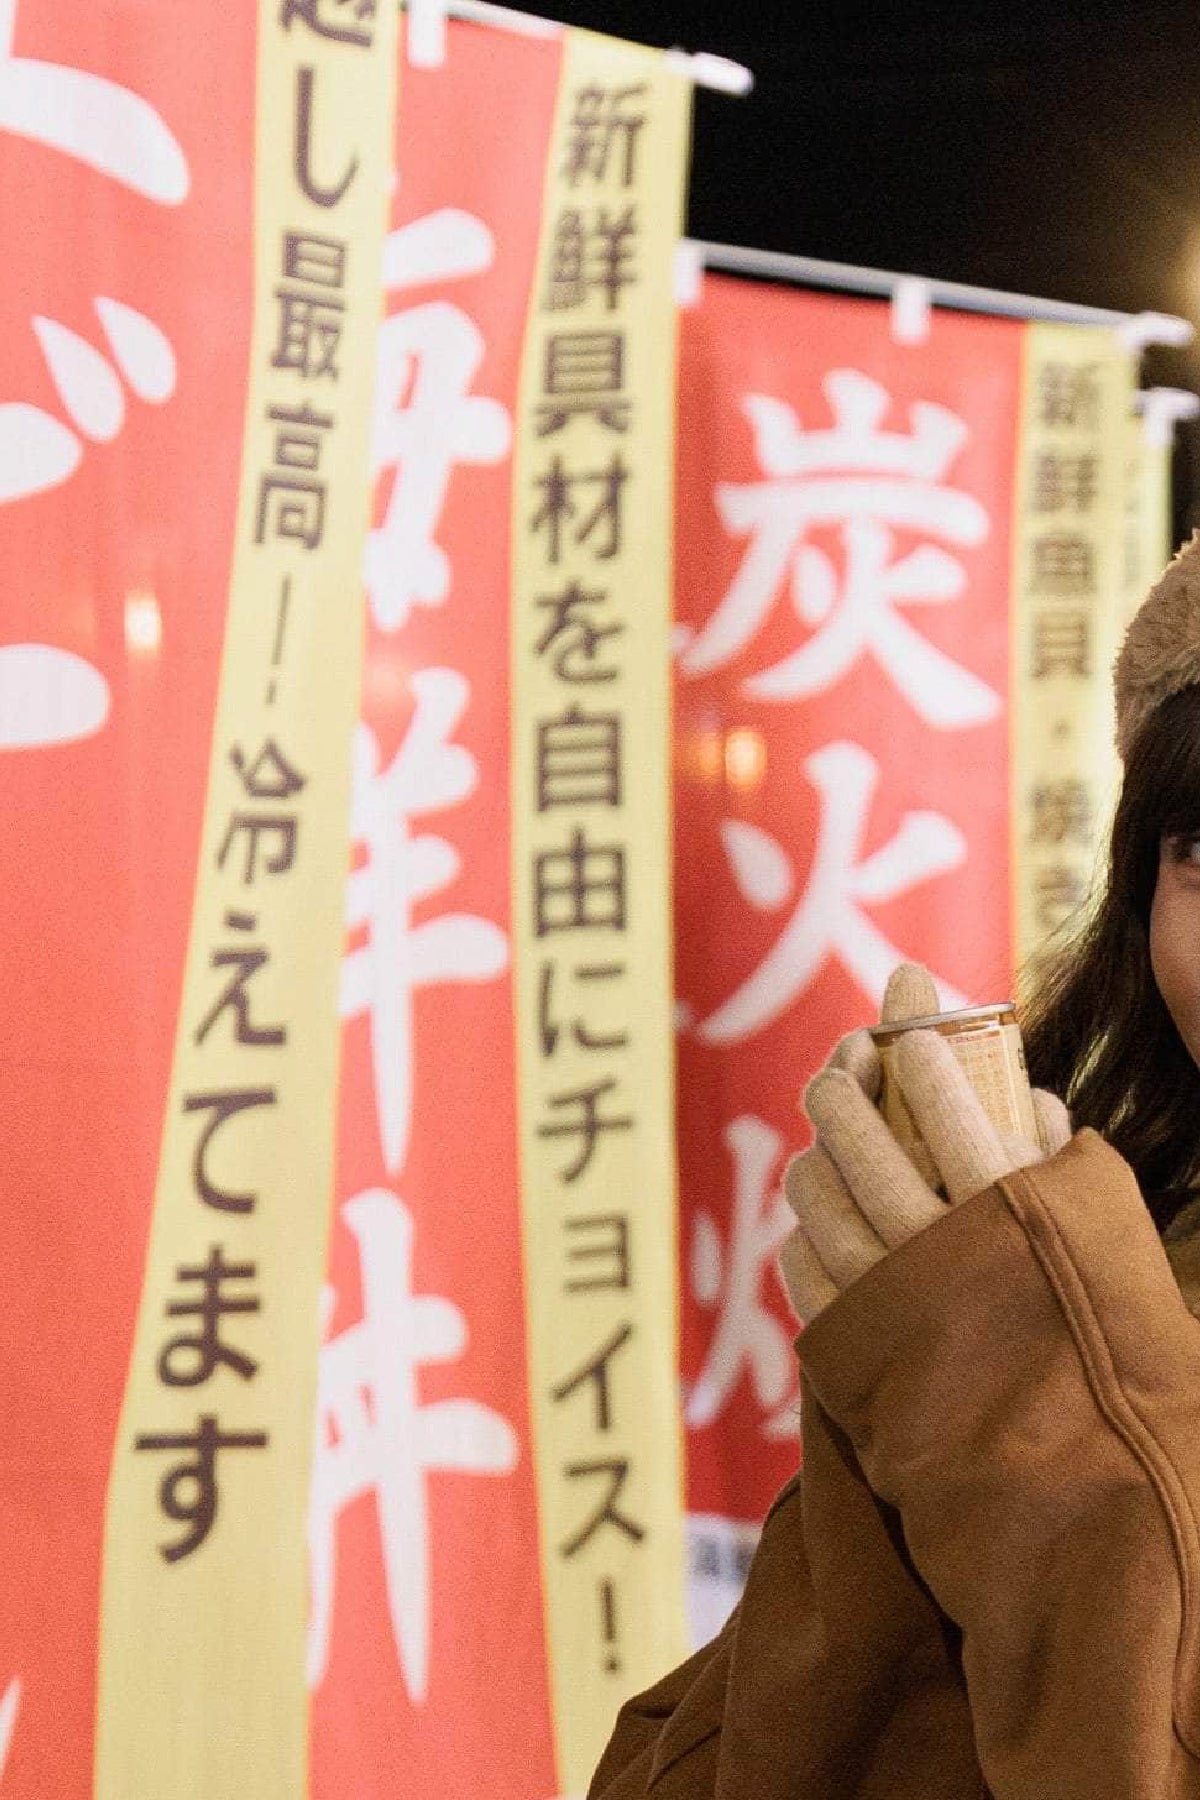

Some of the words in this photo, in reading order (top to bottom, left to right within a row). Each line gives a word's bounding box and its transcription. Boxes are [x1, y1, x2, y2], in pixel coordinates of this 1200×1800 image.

[532, 84, 647, 1673] 新鮮具材を自由にチョイス！
